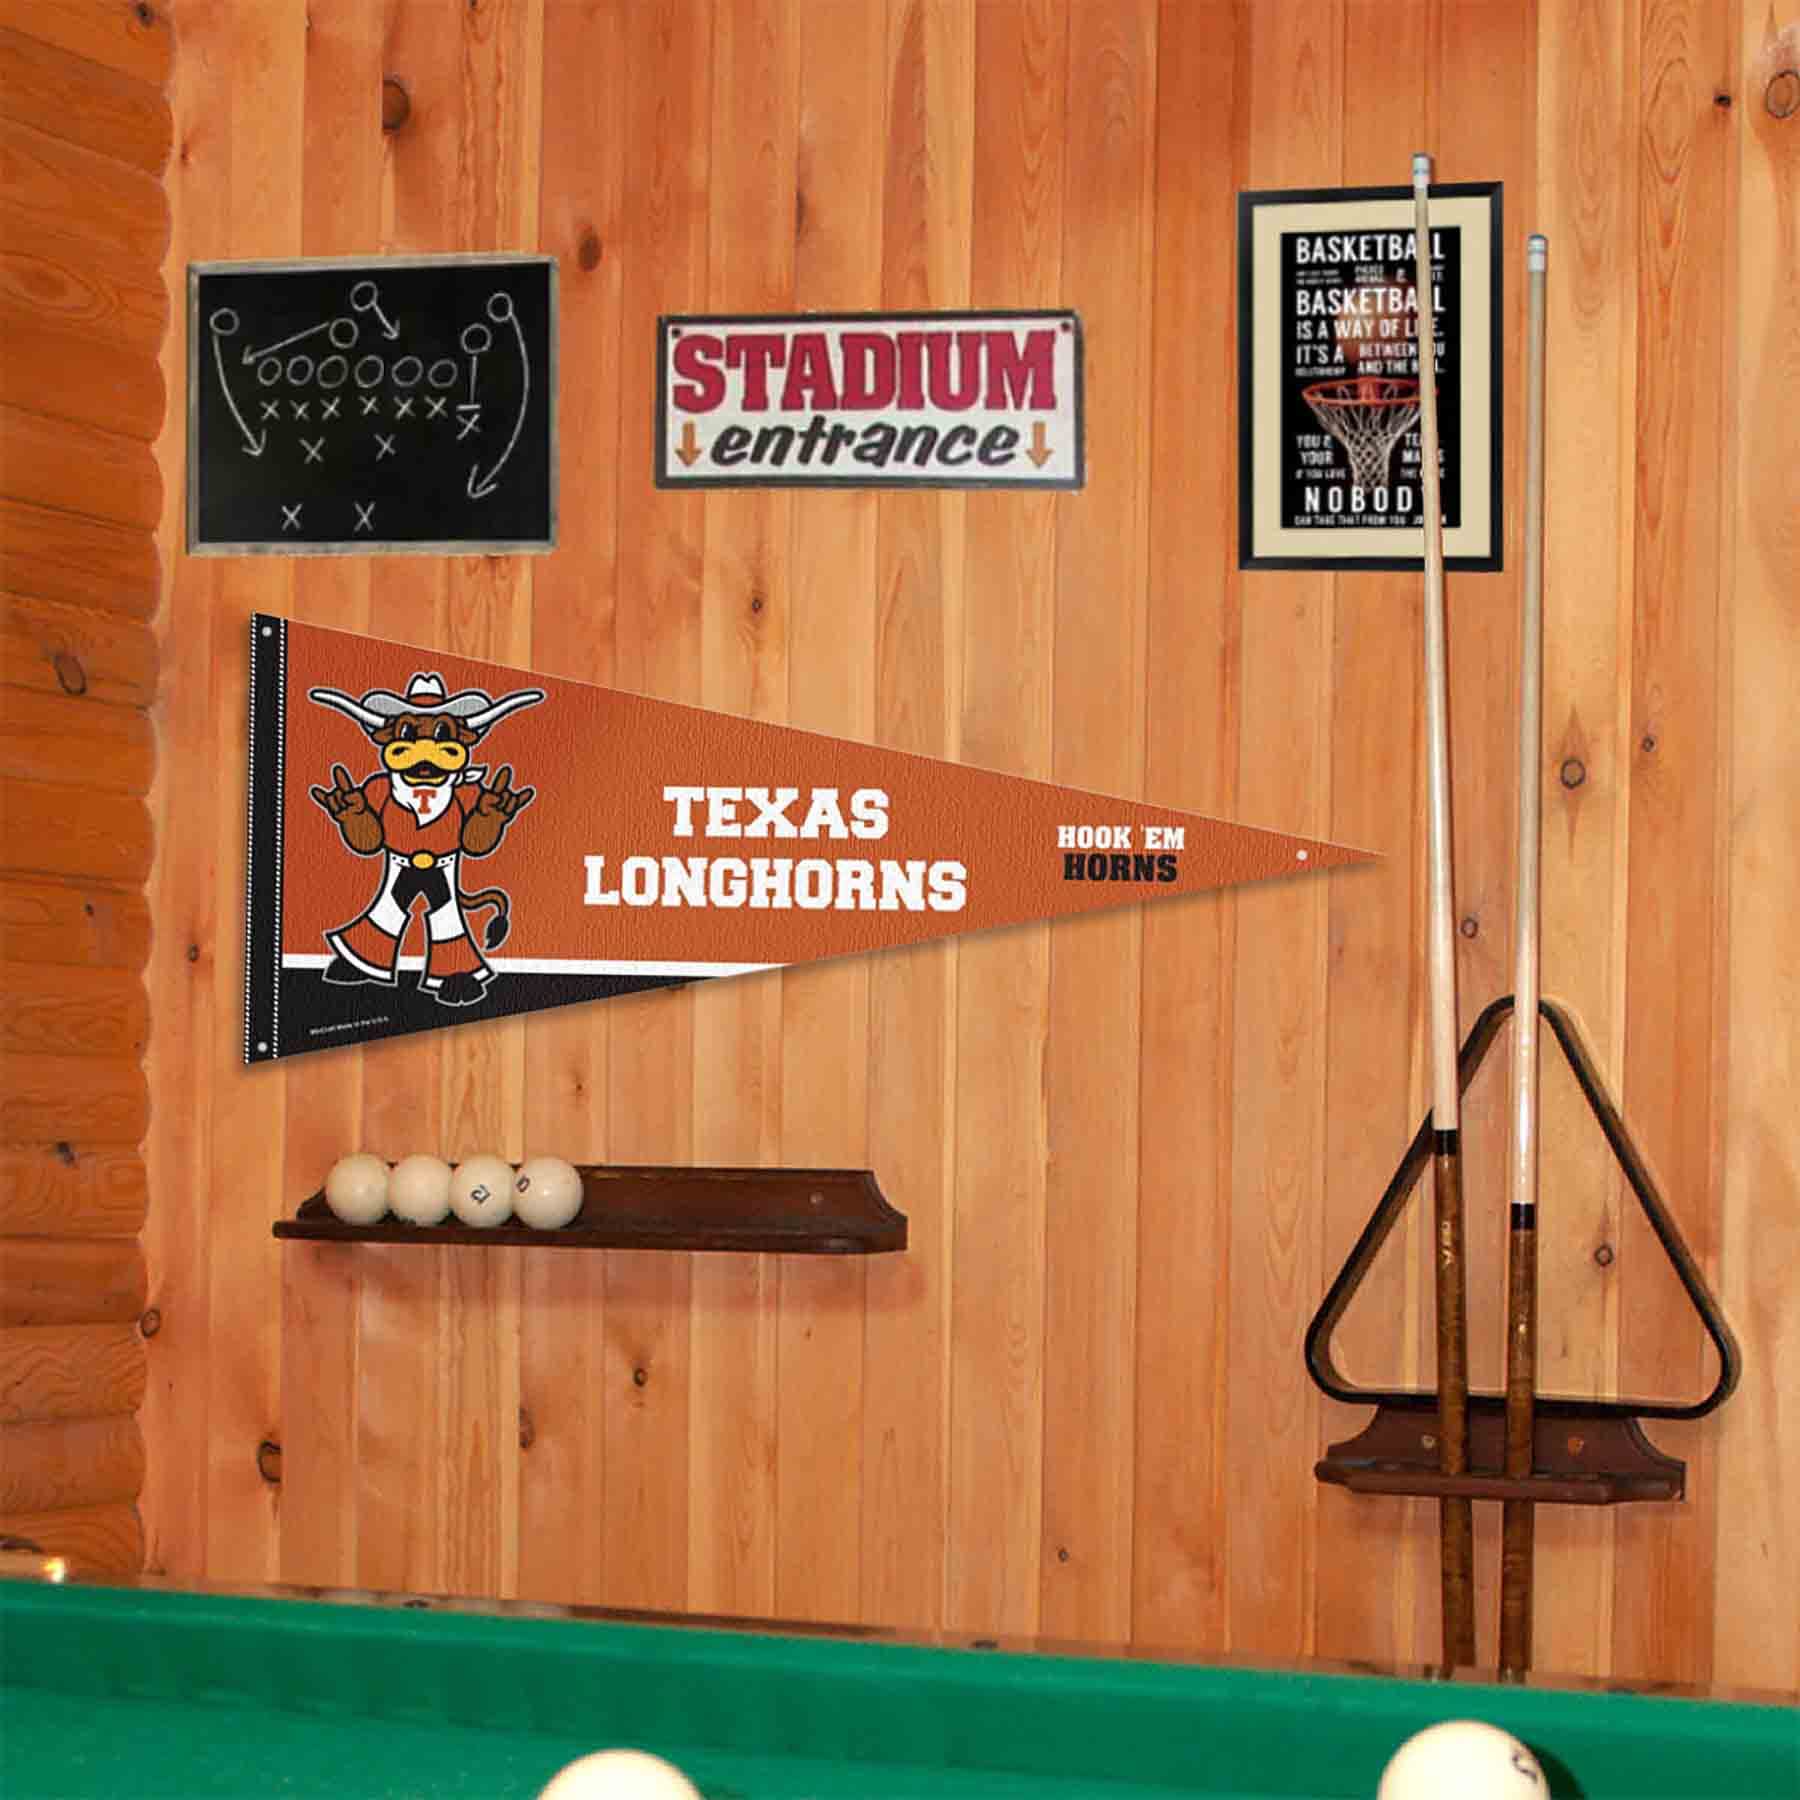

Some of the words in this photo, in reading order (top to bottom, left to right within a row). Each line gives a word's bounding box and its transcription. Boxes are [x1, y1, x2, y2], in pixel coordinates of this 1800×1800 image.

[1295, 232, 1446, 265] BASKETBAL
[1295, 285, 1446, 316] BASKETBAL
[1296, 320, 1312, 340] IS
[1317, 320, 1329, 340] A
[1333, 319, 1374, 339] WAY
[1379, 318, 1399, 338] OF
[1296, 344, 1329, 365] IT'S
[1333, 344, 1345, 365] A
[1358, 360, 1383, 376] AND
[1386, 359, 1409, 375] THE
[672, 331, 1057, 413] STADIUM
[711, 416, 1020, 467] entrance
[1304, 486, 1420, 513] NOBOD
[412, 788, 437, 815] T
[663, 786, 889, 840] TEXAS
[1057, 824, 1132, 849] HOOK
[1140, 824, 1185, 850] 'EM
[1063, 853, 1178, 882] HORNS
[583, 855, 968, 912] LONGHORNS
